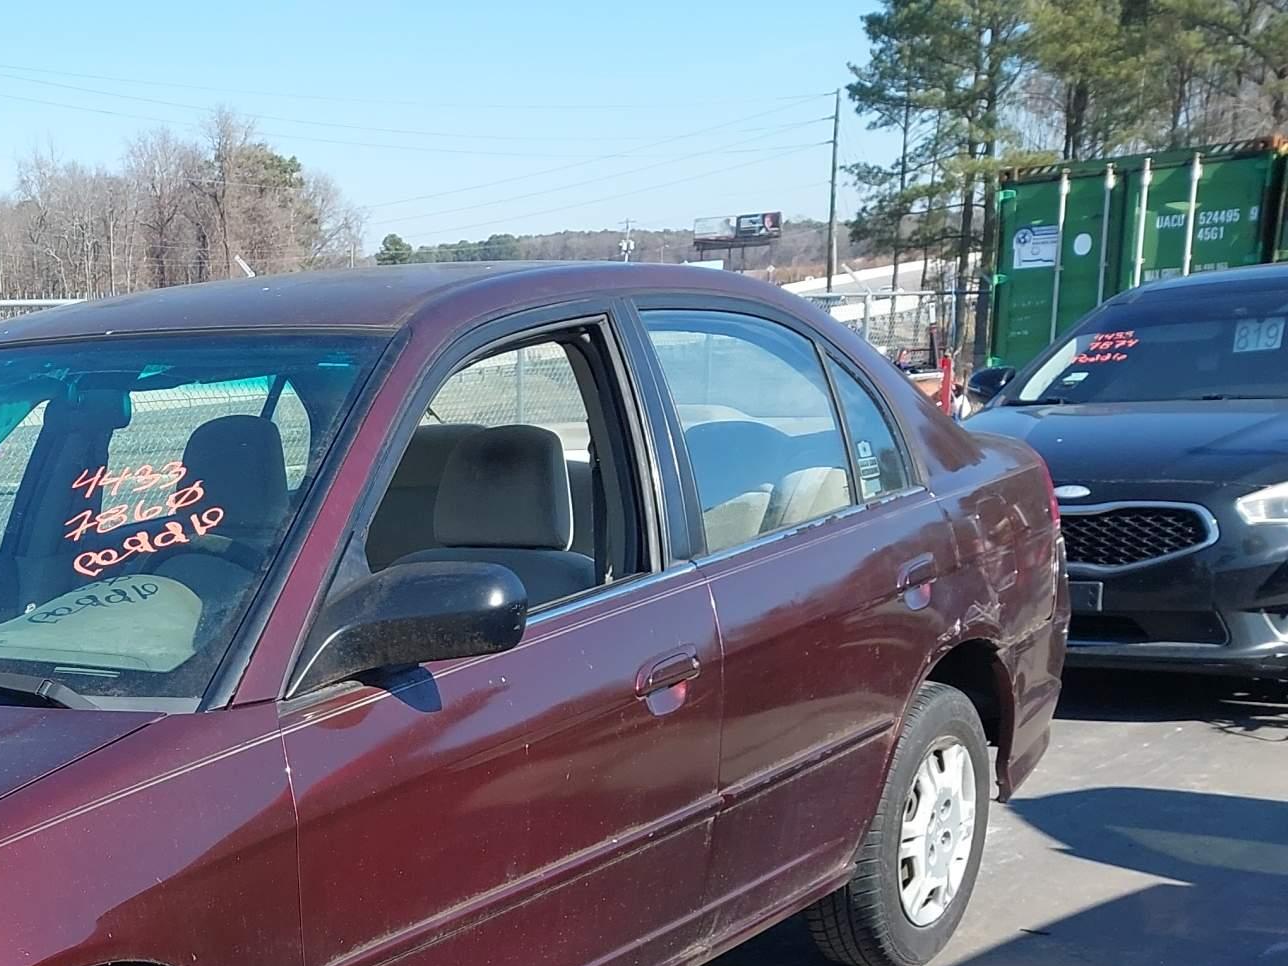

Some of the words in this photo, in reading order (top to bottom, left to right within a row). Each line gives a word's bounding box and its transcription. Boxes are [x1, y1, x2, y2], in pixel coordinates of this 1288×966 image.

[1156, 214, 1186, 229] UACU
[1199, 208, 1240, 225] 524495
[1197, 227, 1224, 240] 45G1
[1236, 323, 1279, 350] 819
[72, 460, 187, 498] 4433
